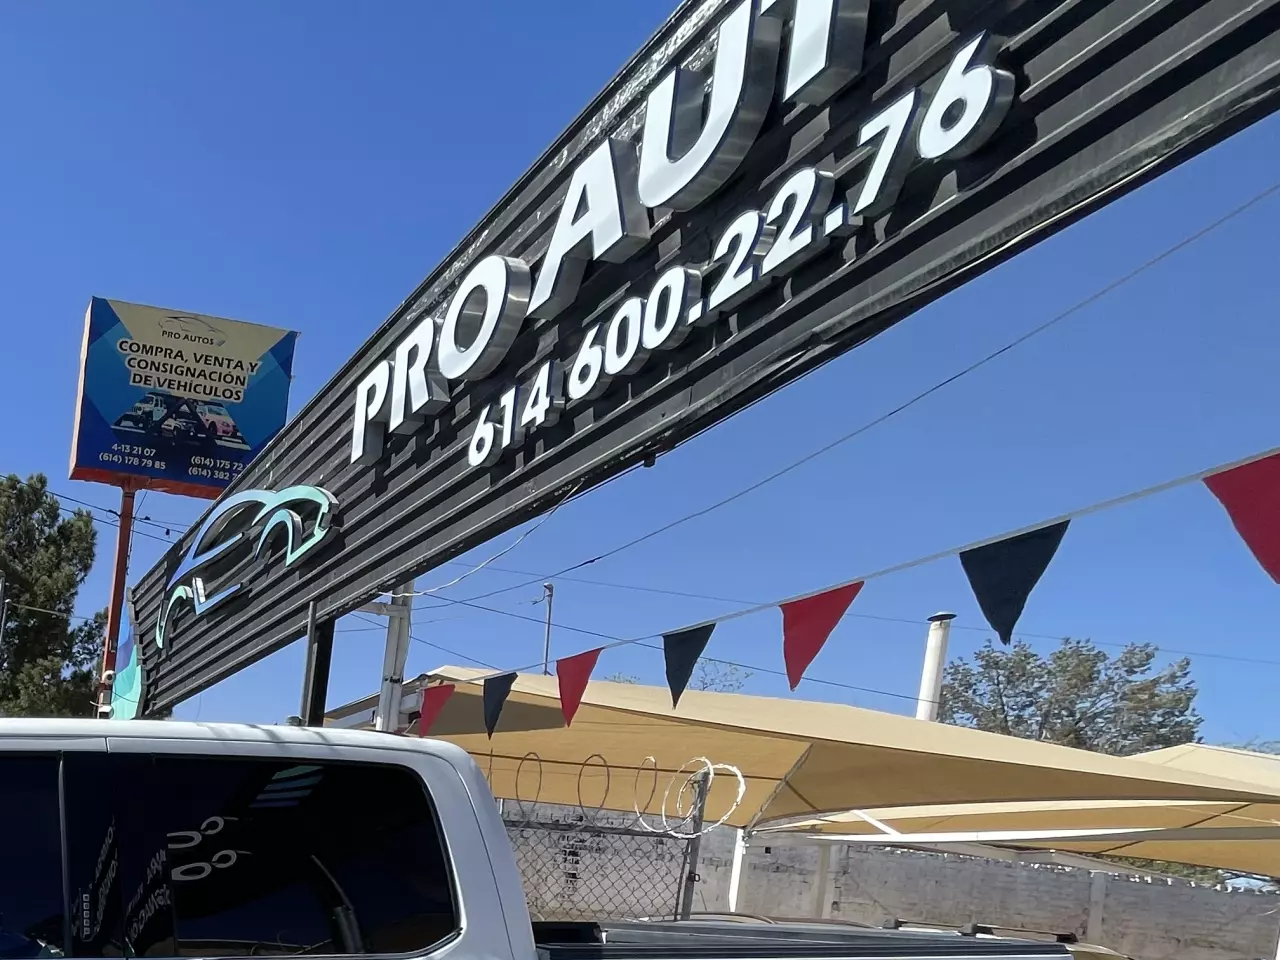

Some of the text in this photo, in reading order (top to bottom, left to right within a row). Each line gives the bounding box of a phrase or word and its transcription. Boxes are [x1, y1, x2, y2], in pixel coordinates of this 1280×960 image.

[469, 30, 992, 466] 614 600.22.76
[161, 330, 215, 346] PRO AUTOS
[119, 340, 259, 374] COMPRA, VENTA Y
[351, 255, 512, 464] PRO
[127, 357, 247, 387] CONSIGNACIÓN
[131, 373, 242, 401] DE VEHÍCULOS
[99, 452, 167, 470] (614) 178 79 85
[111, 443, 157, 457] 4-13 21 07
[188, 466, 212, 478] (614)
[191, 455, 244, 471] (614) 175 72
